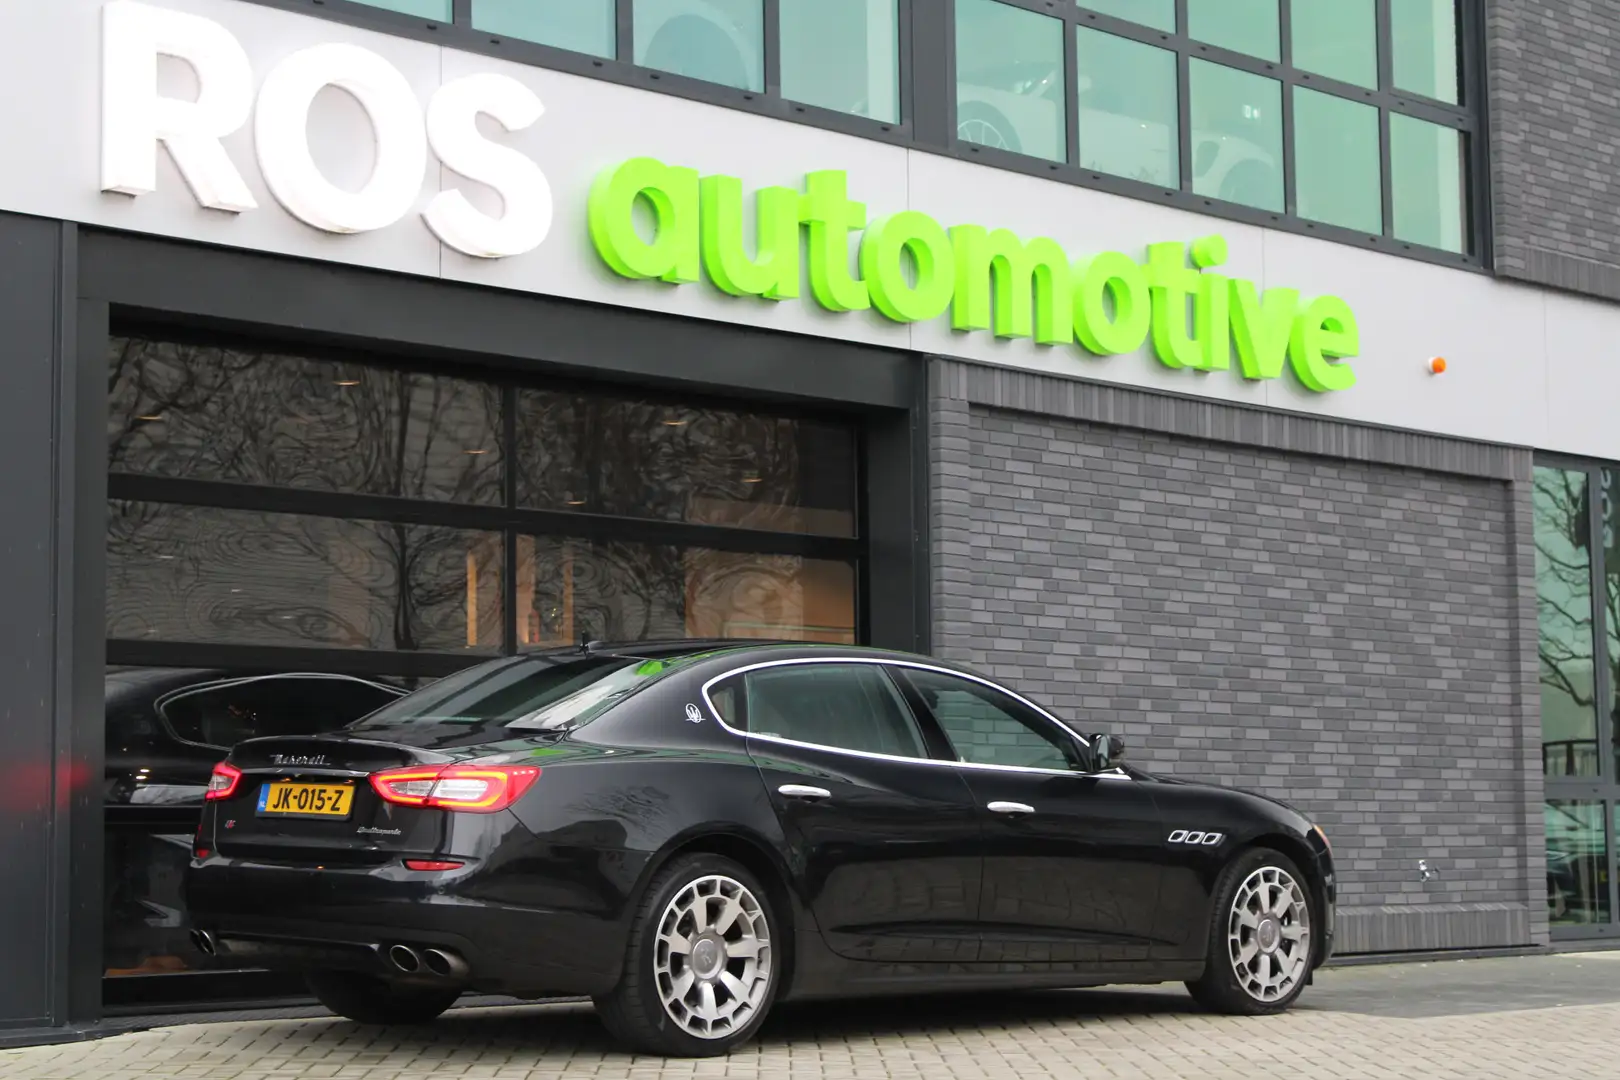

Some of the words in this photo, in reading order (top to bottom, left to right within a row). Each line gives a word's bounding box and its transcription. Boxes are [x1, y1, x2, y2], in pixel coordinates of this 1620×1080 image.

[101, 0, 554, 258] ROS
[587, 156, 1359, 394] automotive
[272, 787, 344, 812] JK-015-Z
